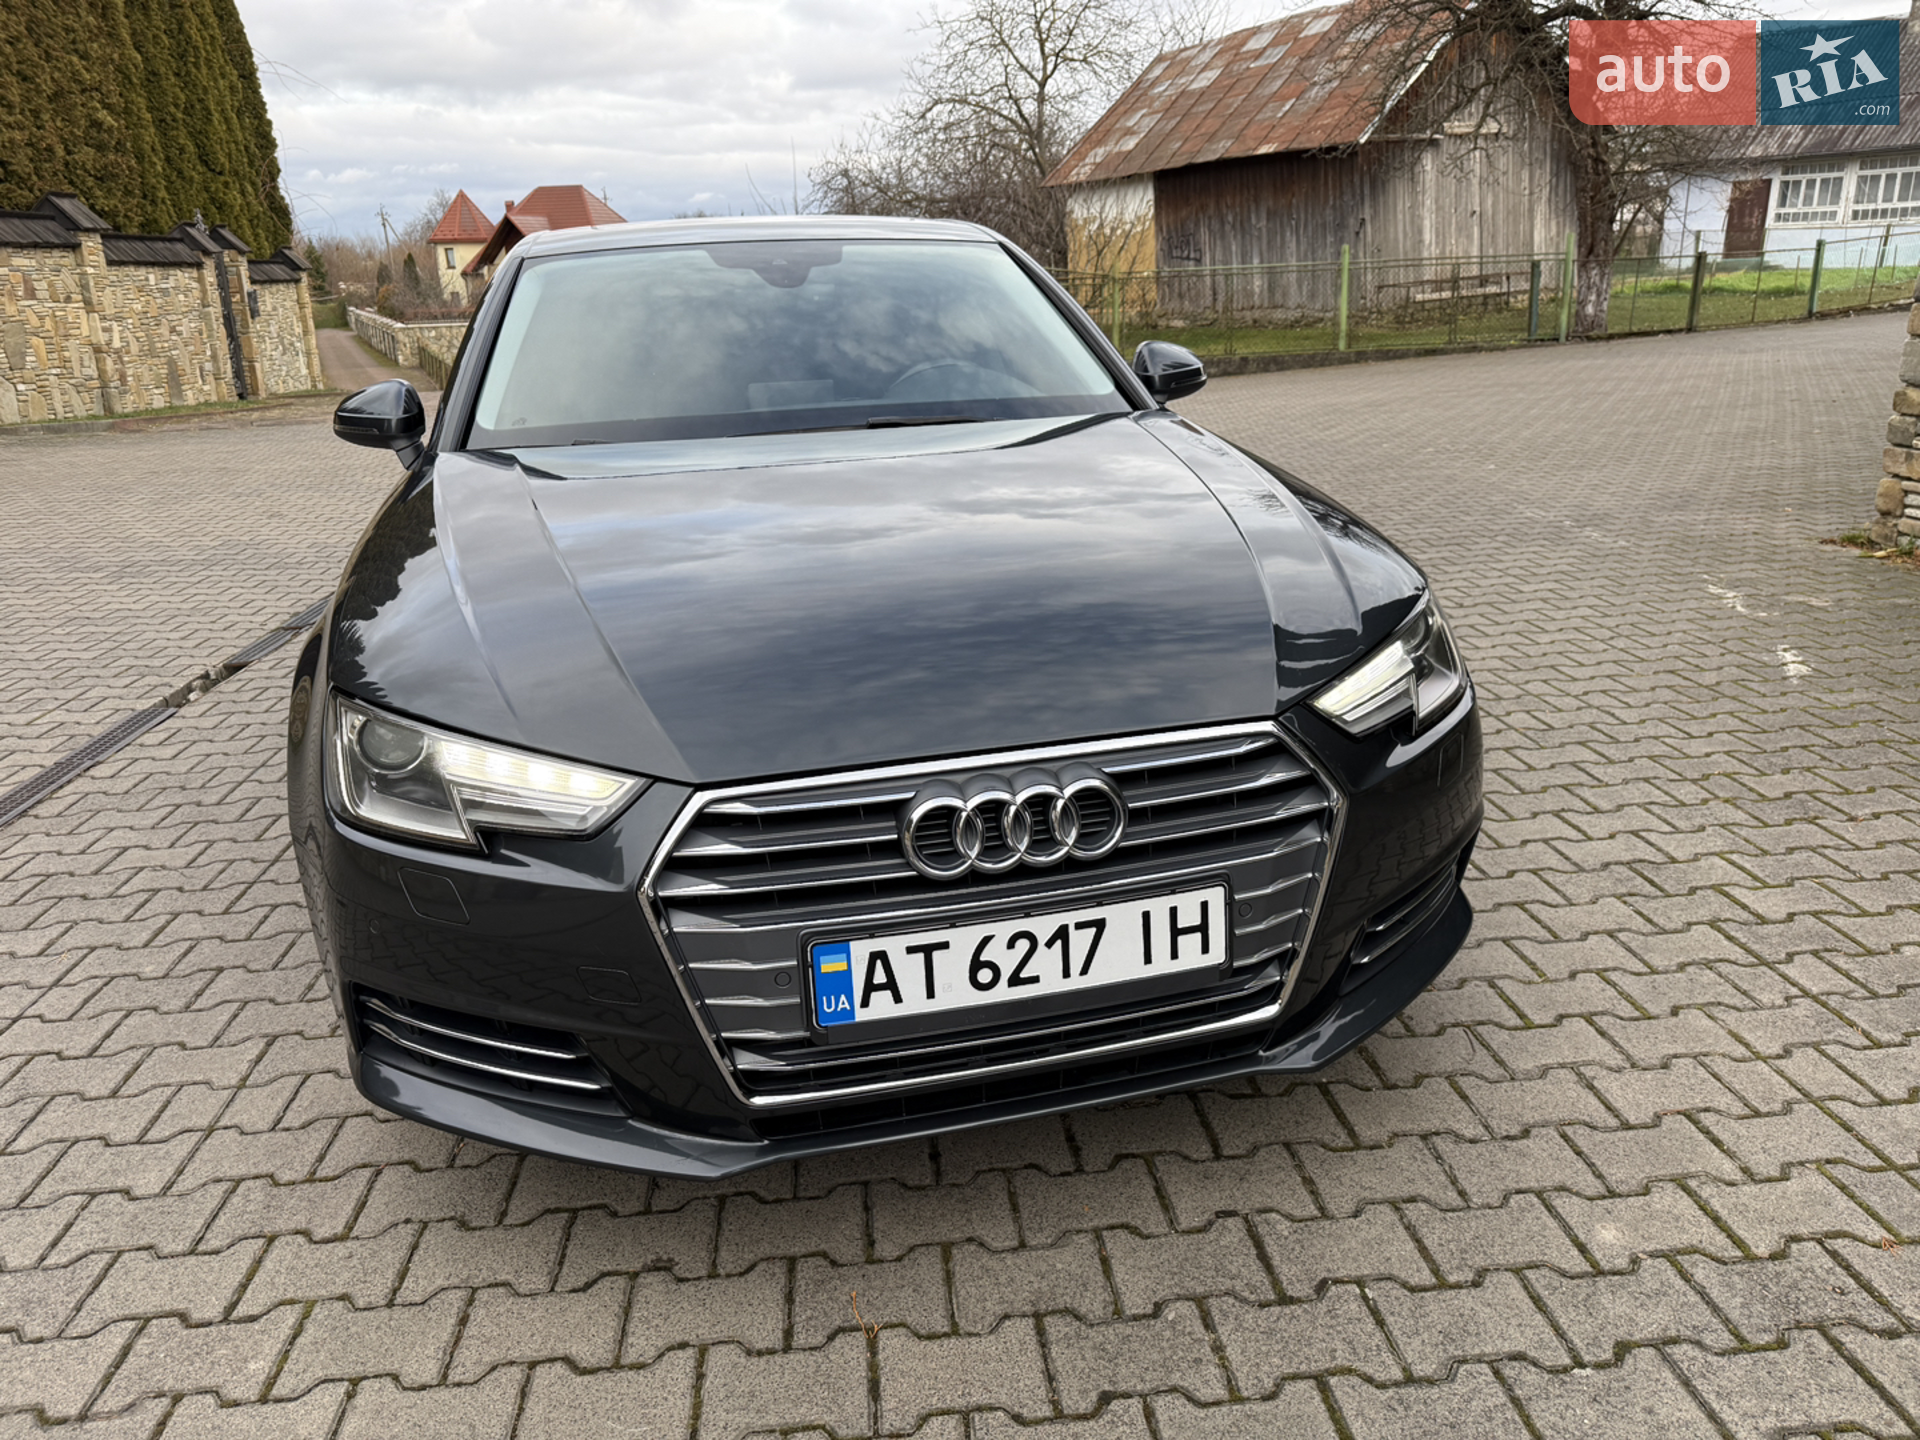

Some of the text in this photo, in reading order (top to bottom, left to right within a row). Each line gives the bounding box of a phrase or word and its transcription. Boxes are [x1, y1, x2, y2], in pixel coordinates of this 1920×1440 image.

[860, 900, 1210, 1009] AT 6217 IH
[822, 994, 851, 1013] UA
